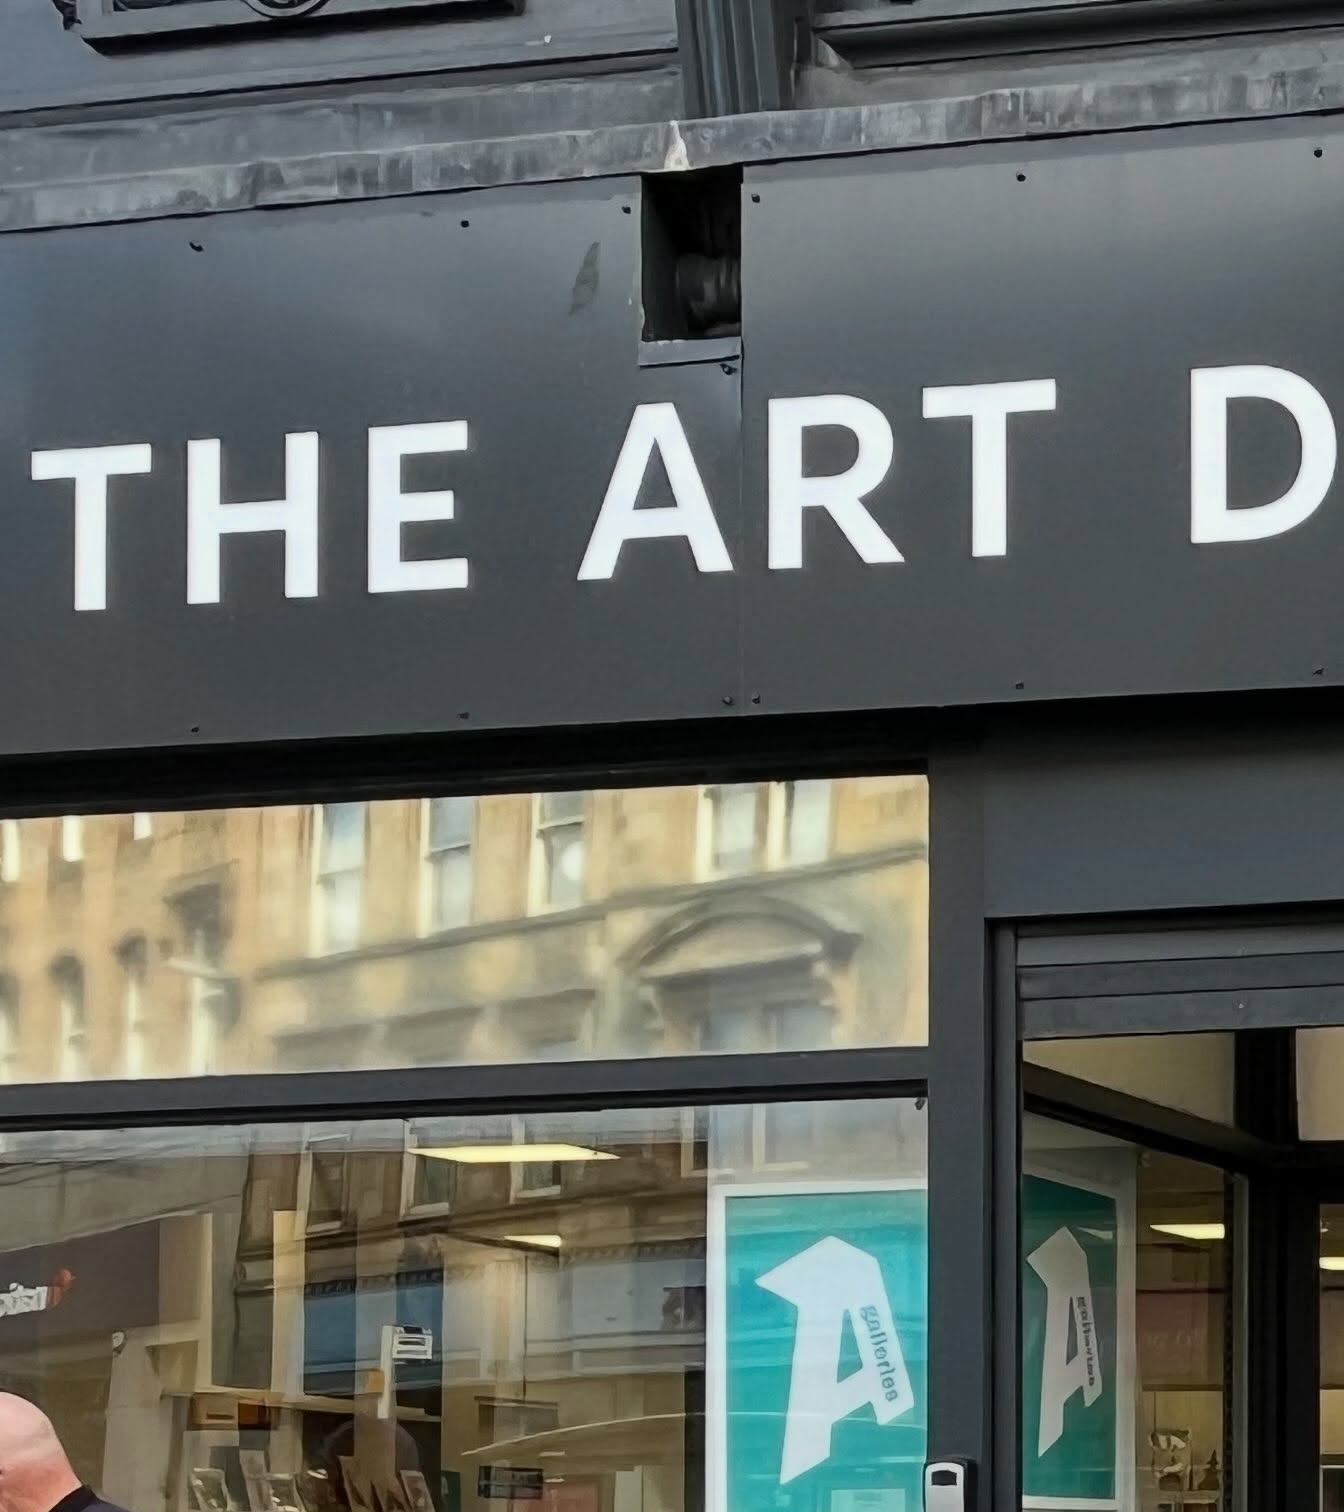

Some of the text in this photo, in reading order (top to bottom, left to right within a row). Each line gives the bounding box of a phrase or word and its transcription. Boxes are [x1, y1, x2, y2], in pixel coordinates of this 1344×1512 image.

[32, 421, 468, 610] THE
[577, 379, 1056, 580] ART
[859, 1304, 899, 1403] galleries
